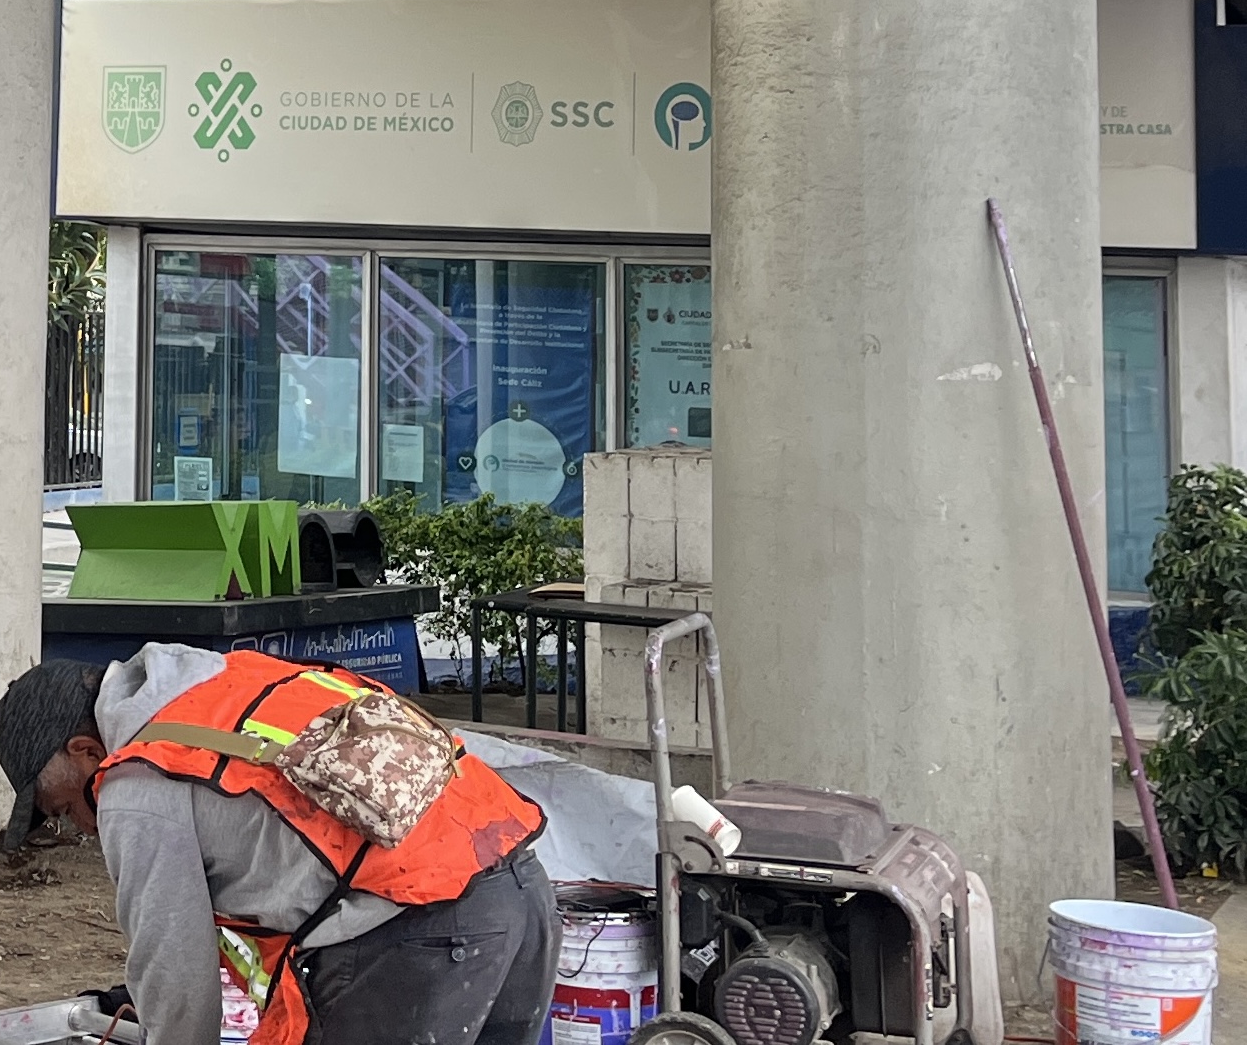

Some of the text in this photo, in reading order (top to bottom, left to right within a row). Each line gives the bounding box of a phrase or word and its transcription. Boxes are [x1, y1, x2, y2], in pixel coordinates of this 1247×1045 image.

[279, 91, 454, 109] GOBIERNO DE LA
[550, 101, 614, 127] SSC
[1111, 106, 1127, 117] DE
[279, 112, 454, 132] CIUDAD DE MÉXICO
[1137, 124, 1172, 135] CASA
[678, 310, 712, 319] CIUDAD
[492, 364, 548, 376] Inauguración
[498, 377, 519, 387] Sede
